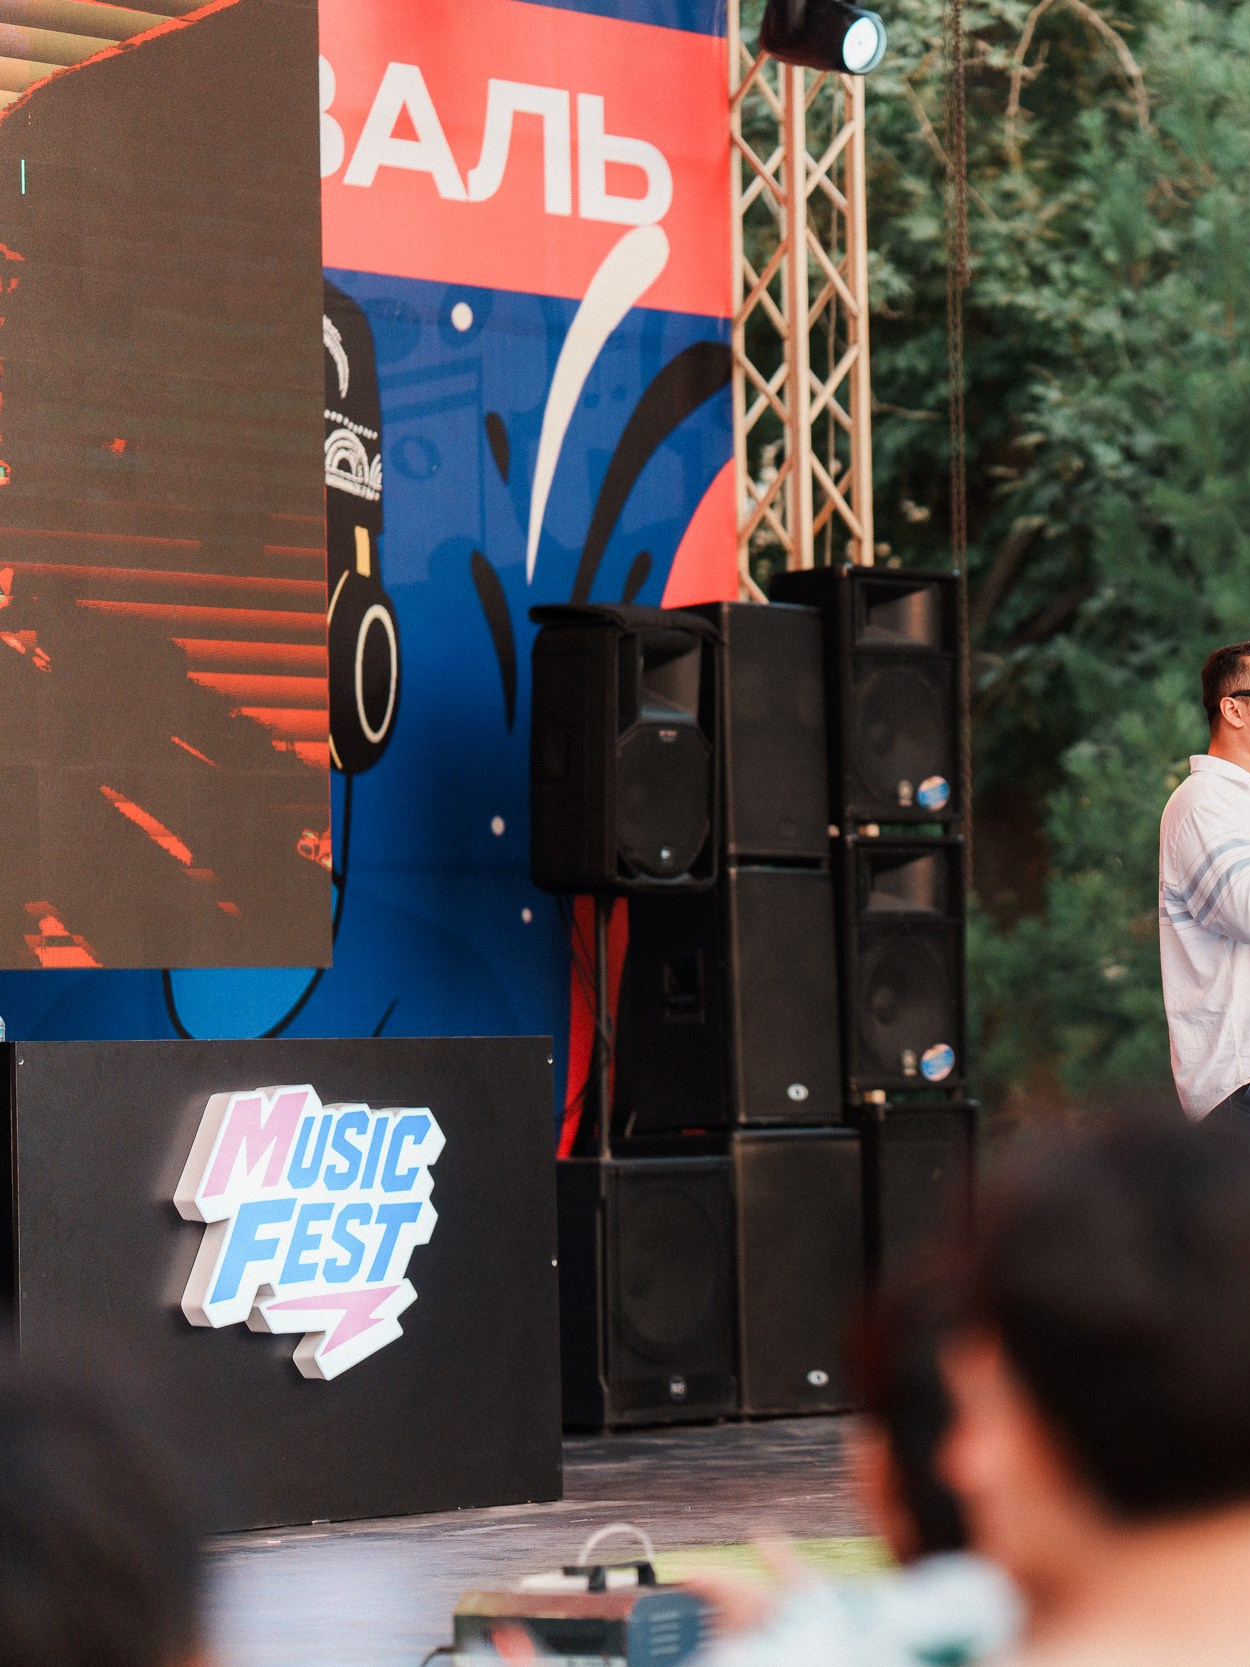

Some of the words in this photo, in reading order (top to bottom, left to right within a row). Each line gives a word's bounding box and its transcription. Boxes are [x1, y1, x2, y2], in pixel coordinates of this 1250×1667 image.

[319, 55, 673, 226] АЛЬ
[202, 1091, 432, 1198] MUSIC
[209, 1198, 423, 1305] FEST
